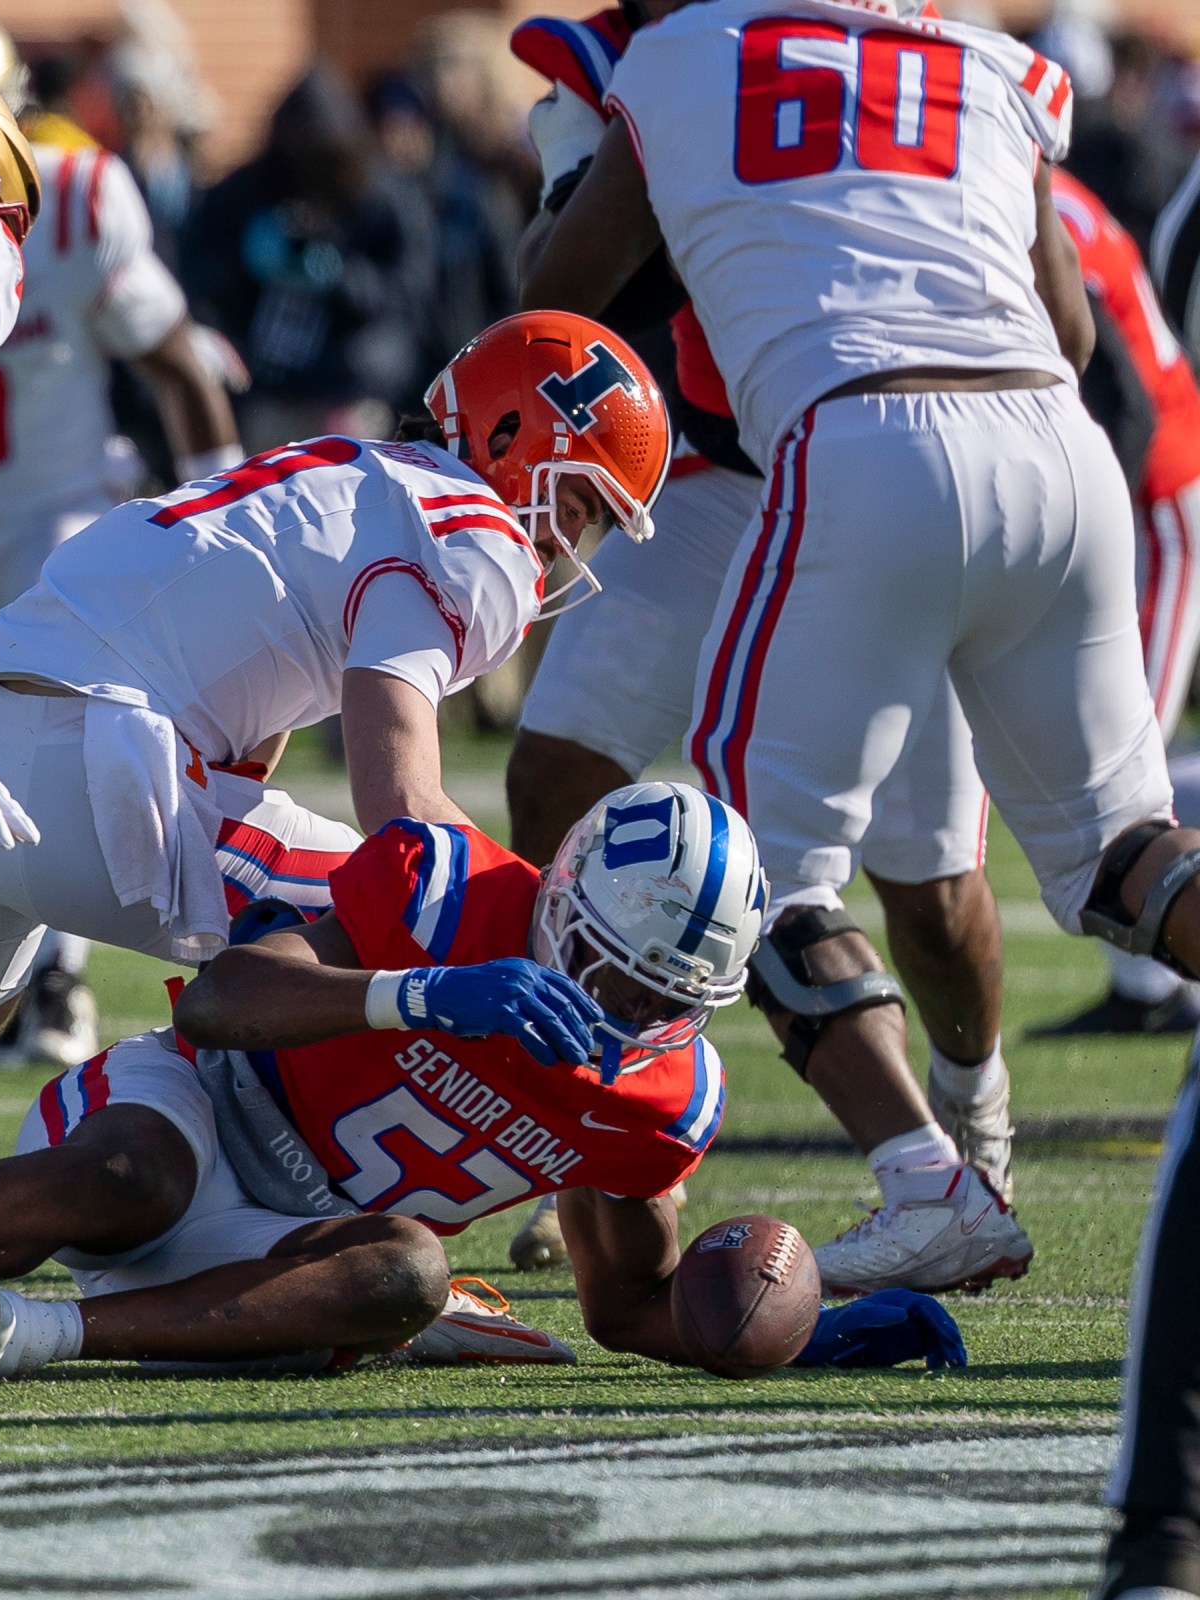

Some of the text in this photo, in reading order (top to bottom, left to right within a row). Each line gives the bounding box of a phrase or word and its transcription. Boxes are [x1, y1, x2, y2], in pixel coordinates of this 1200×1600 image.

[734, 16, 968, 186] 60
[406, 977, 427, 1018] NIKE
[269, 1130, 312, 1182] 1100
[394, 1038, 583, 1185] SENIOR BOWL
